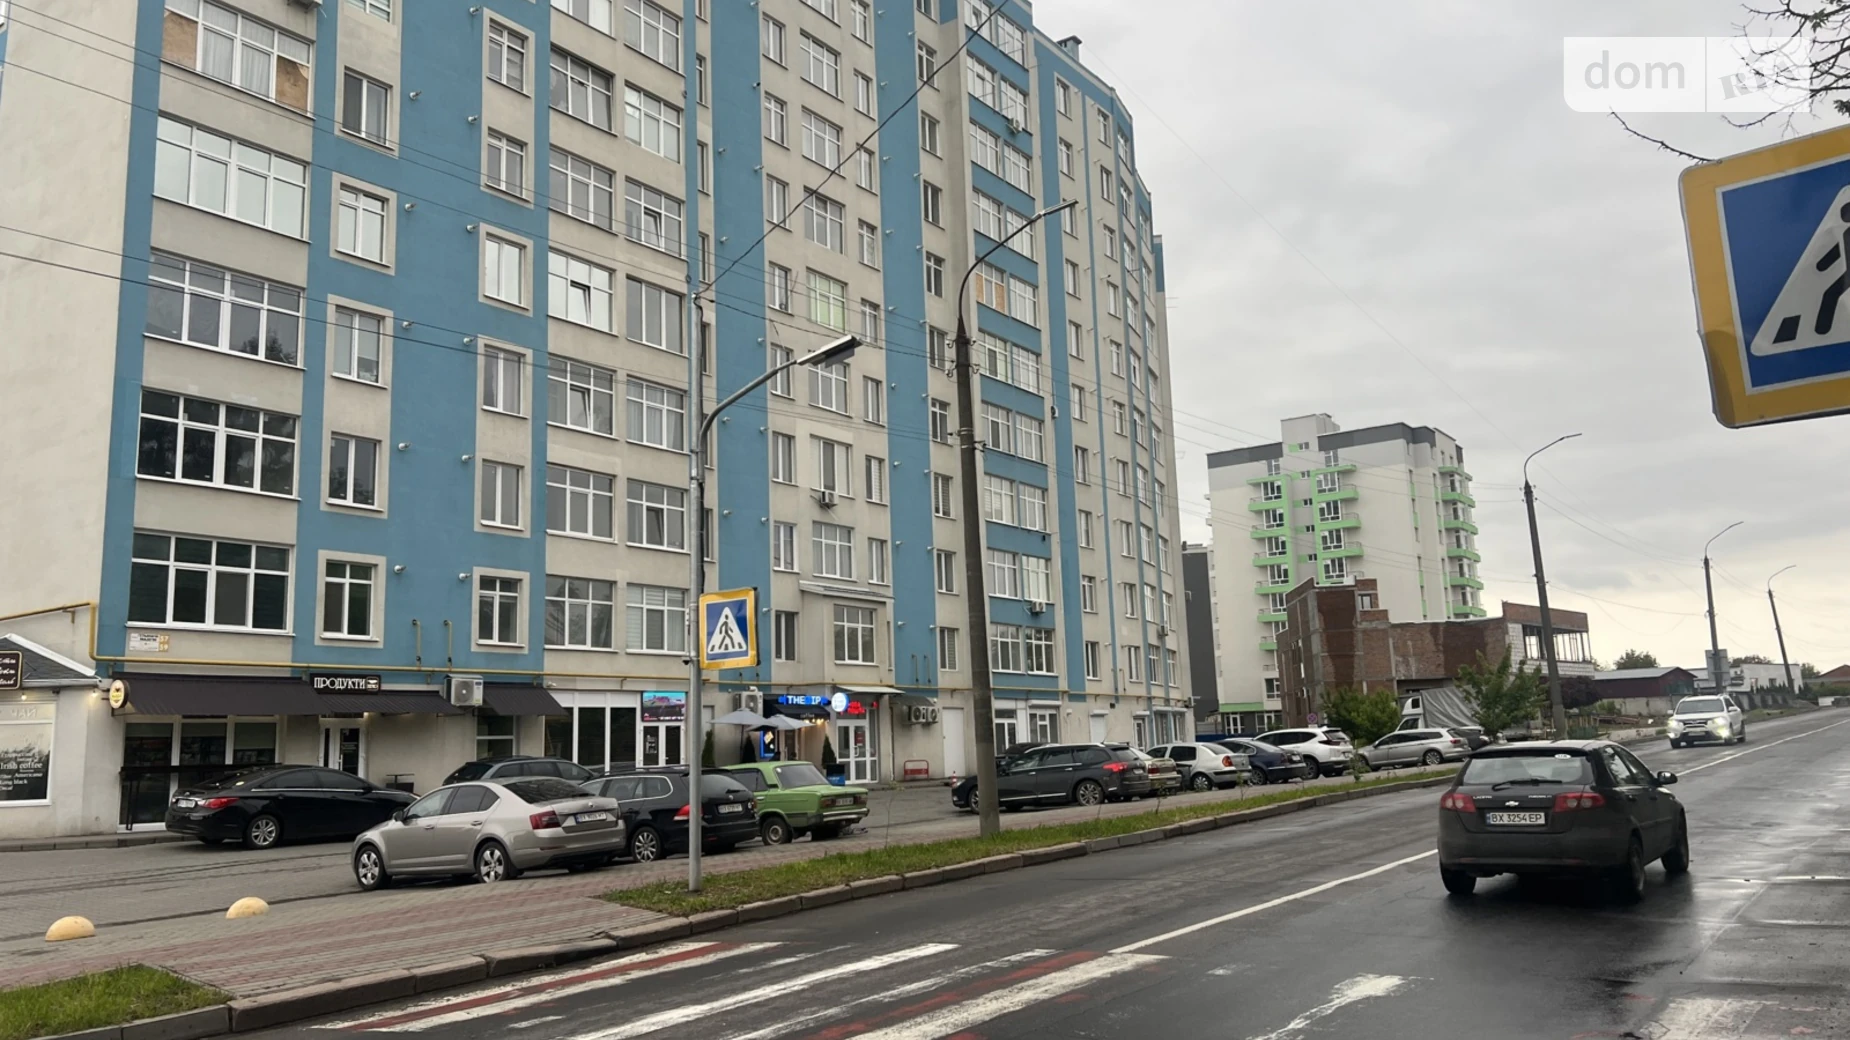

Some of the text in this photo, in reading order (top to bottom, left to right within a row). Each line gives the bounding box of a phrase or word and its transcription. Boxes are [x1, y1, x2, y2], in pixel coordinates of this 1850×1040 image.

[313, 677, 366, 690] ПРОДУКТИ
[787, 695, 806, 705] THE
[19, 761, 43, 769] coffee
[1491, 813, 1542, 823] BX 3254 EP
